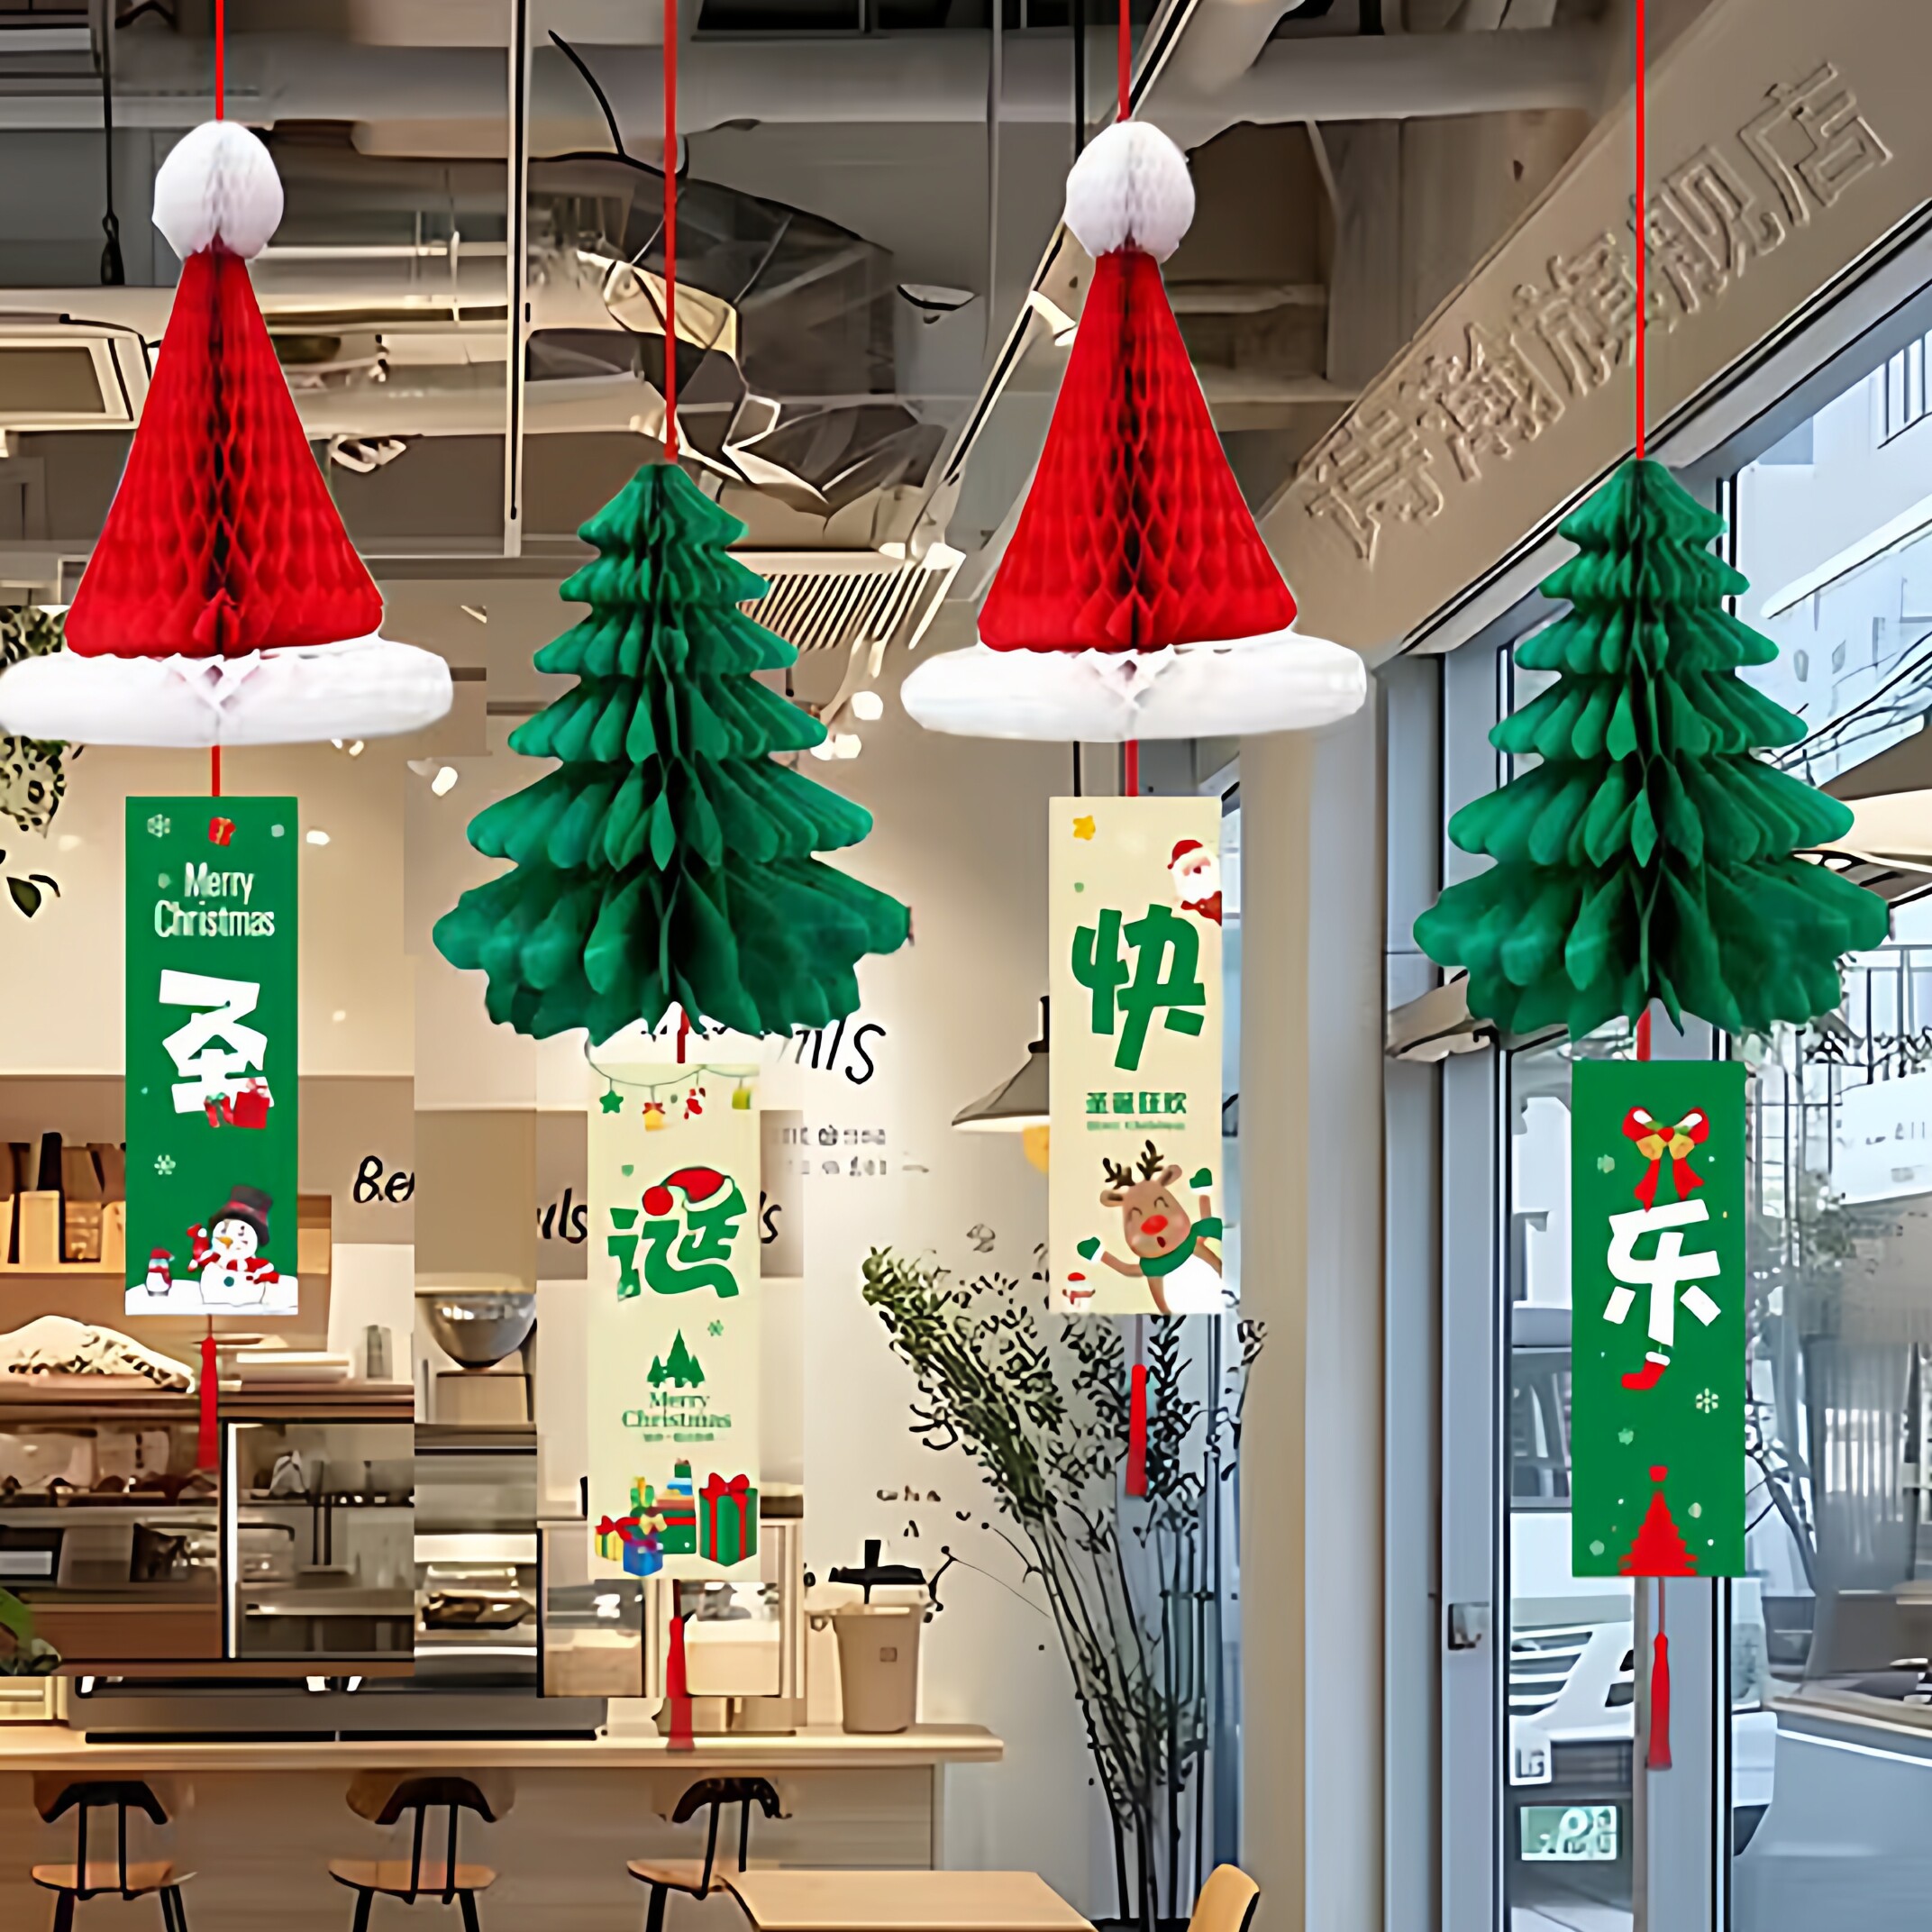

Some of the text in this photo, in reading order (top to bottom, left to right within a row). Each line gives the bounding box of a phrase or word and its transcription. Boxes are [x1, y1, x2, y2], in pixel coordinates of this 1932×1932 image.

[154, 898, 276, 938] Christmas
[184, 861, 256, 906] Merry
[1071, 904, 1206, 1071] 快
[159, 969, 275, 1114] 圣
[607, 1177, 747, 1299] 诞
[1602, 1198, 1722, 1348] 乐
[621, 1409, 732, 1428] Christmas
[649, 1390, 710, 1414] Merry
